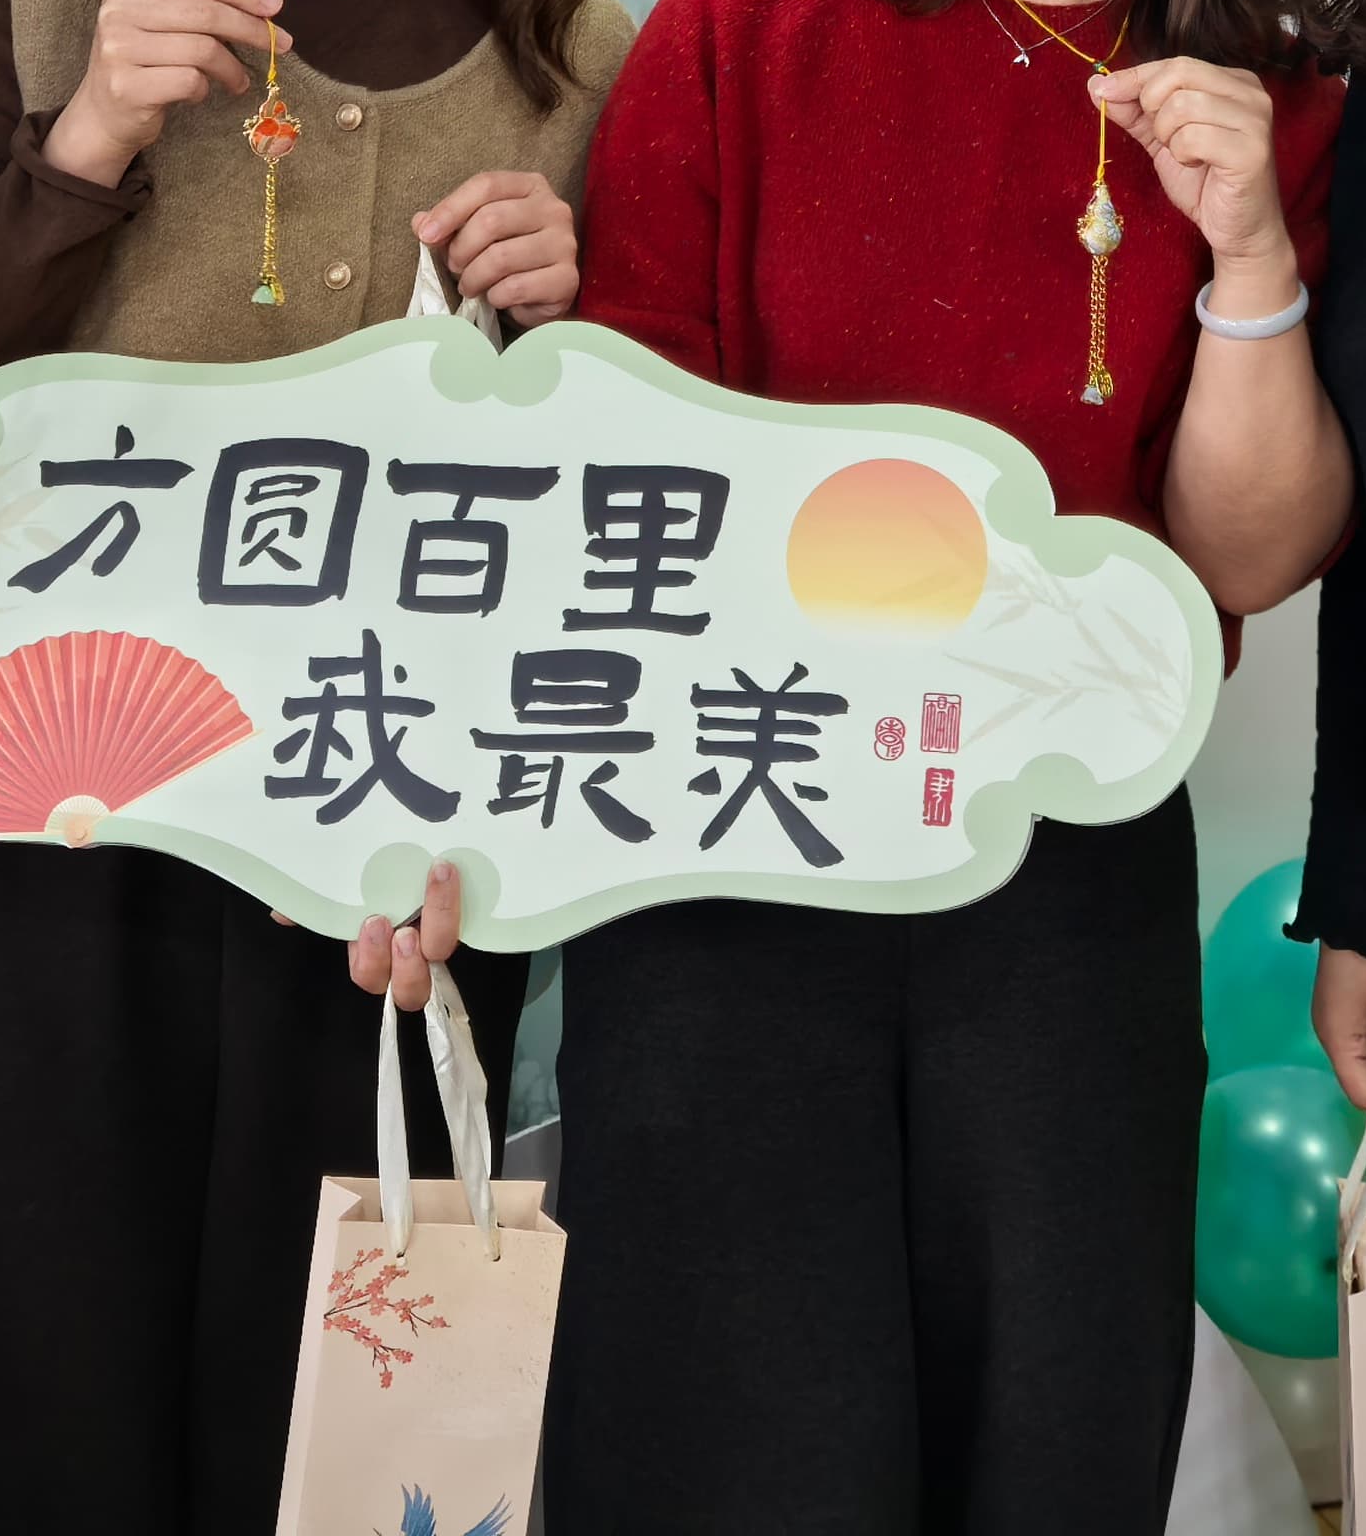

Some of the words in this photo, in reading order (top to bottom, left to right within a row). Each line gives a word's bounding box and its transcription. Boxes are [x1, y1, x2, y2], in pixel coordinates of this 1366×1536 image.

[7, 424, 730, 636] 方圆百里
[264, 628, 849, 868] 我最美
